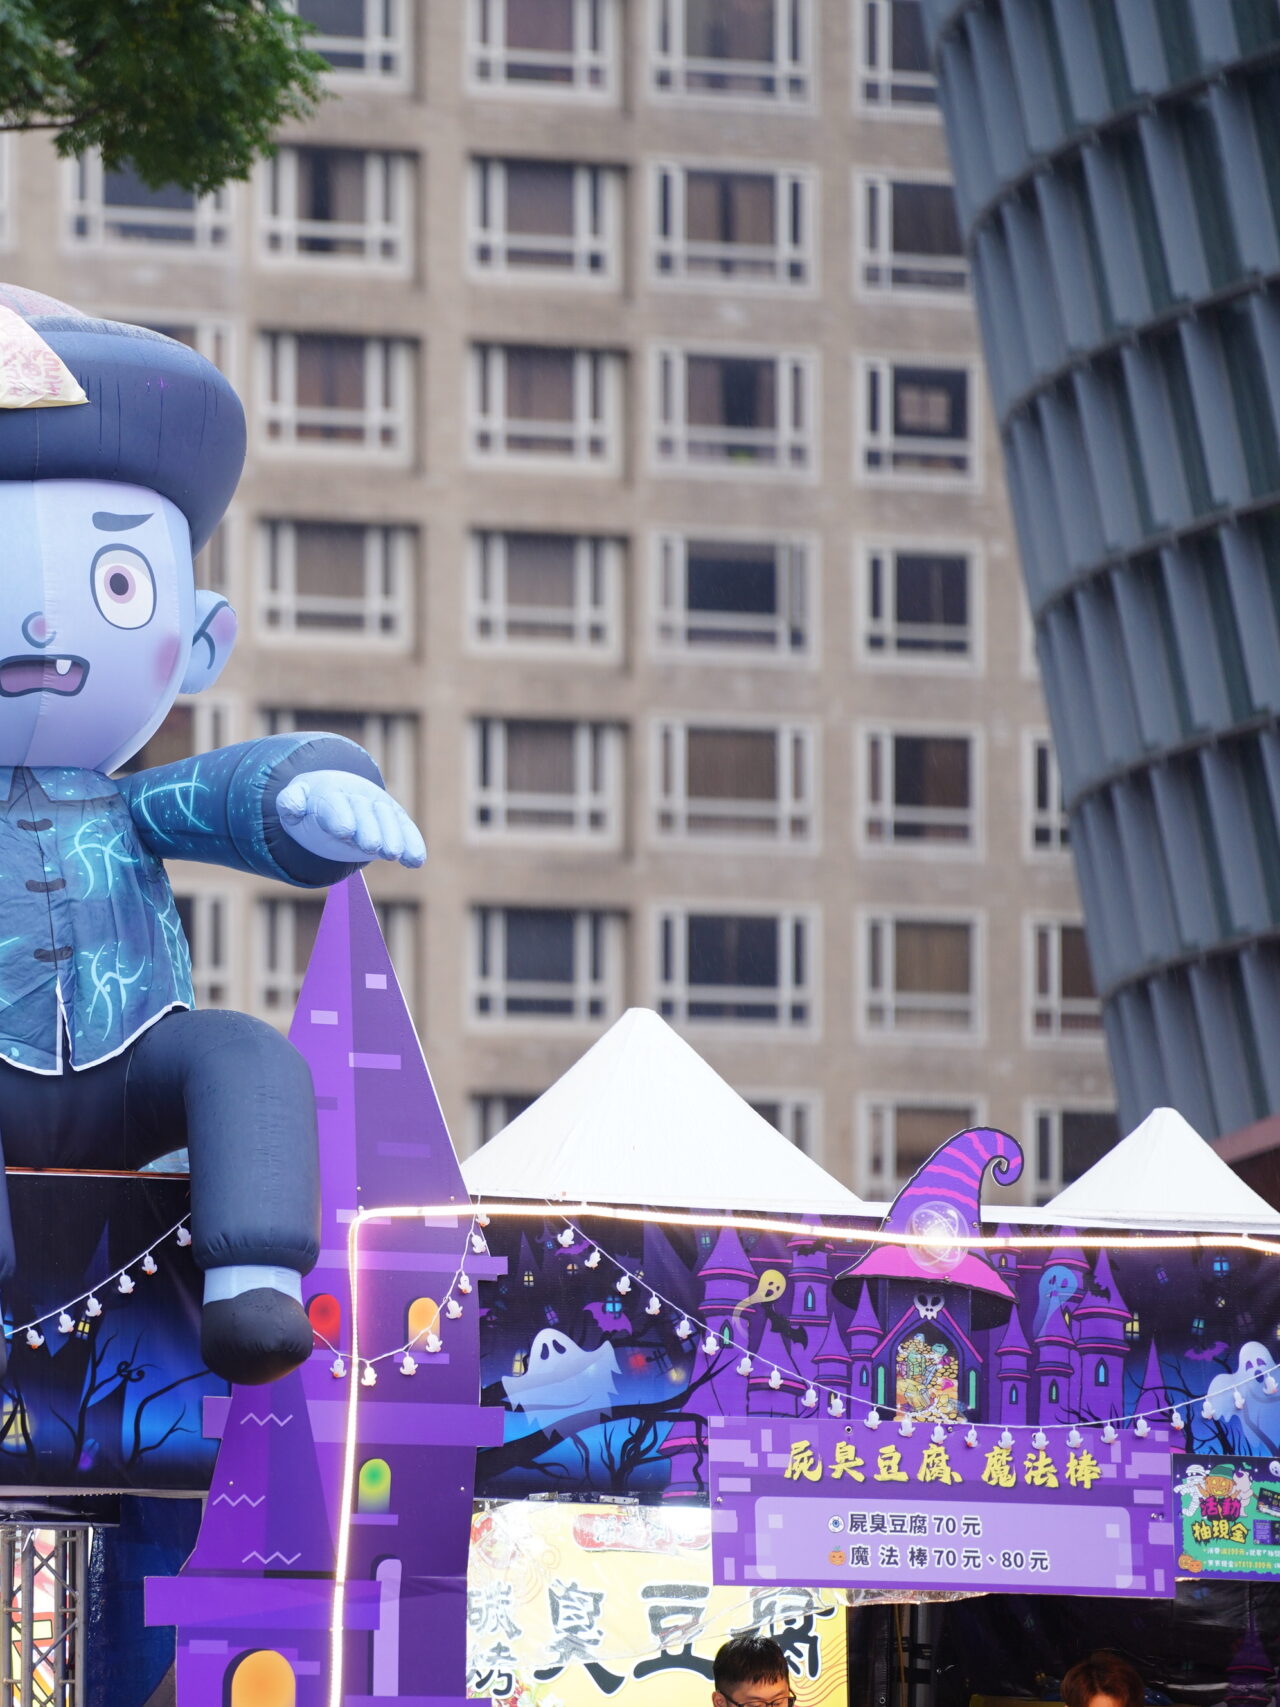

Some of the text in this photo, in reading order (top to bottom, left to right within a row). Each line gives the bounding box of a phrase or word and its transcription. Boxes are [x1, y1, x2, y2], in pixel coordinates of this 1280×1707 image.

[849, 1513, 981, 1536] 屍臭豆腐 70 元
[1192, 1519, 1248, 1544] 抽現金
[849, 1546, 928, 1568] 魔法棒
[933, 1550, 956, 1568] 70
[1030, 1552, 1049, 1571] 元
